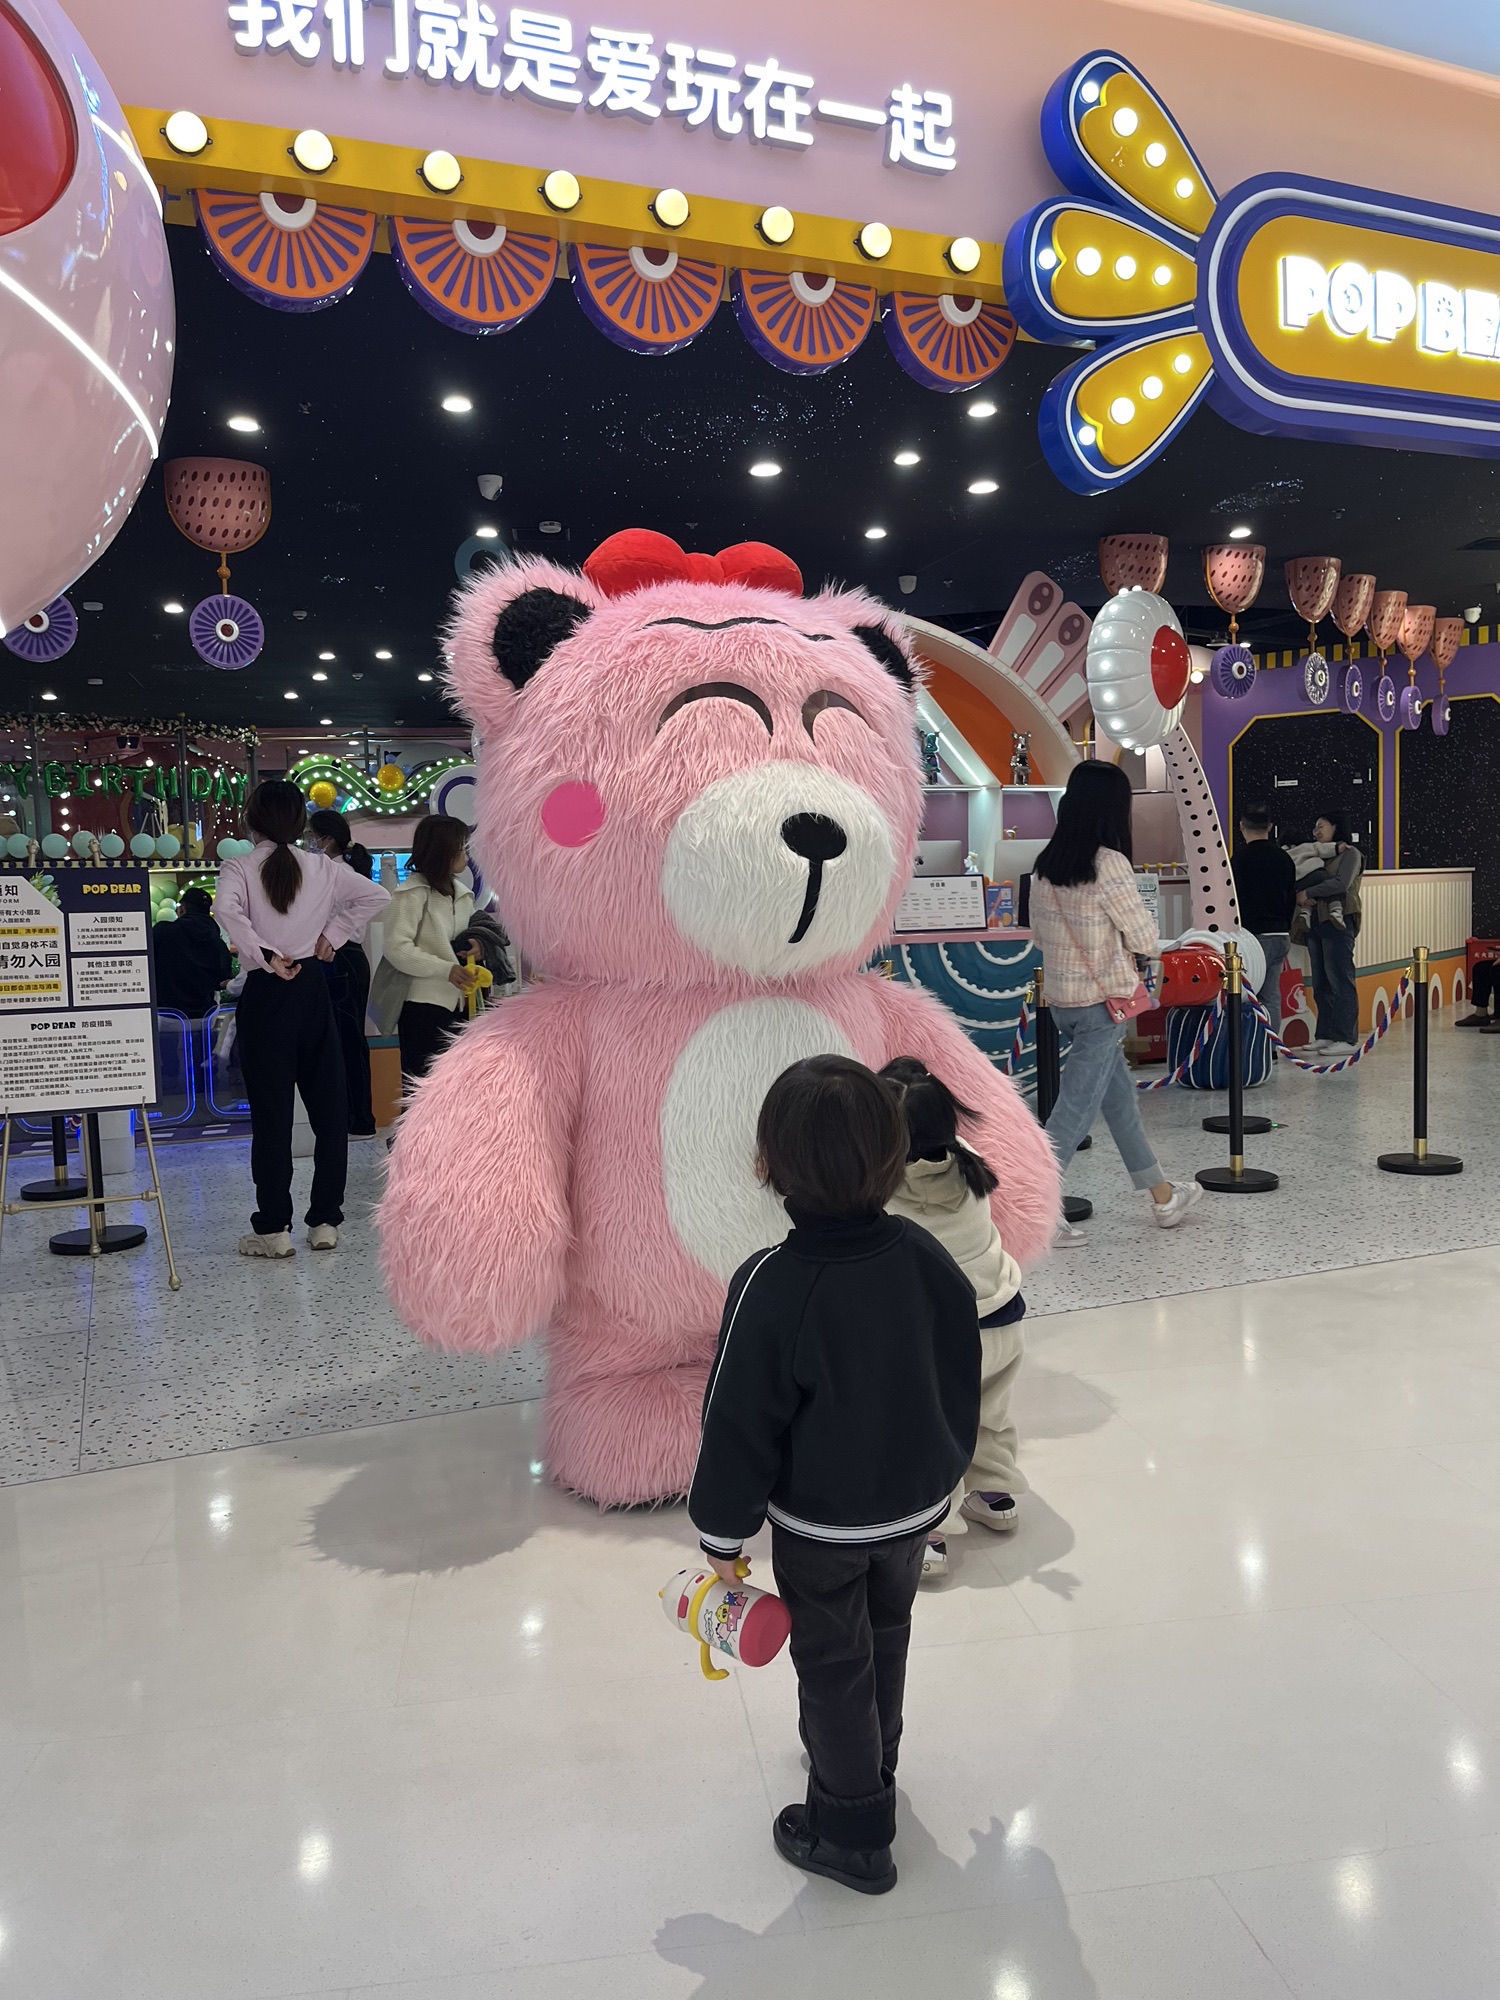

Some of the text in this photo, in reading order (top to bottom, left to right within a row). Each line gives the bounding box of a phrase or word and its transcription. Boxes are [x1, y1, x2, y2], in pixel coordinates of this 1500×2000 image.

[228, 0, 957, 172] 我们就是爱玩在一起
[1279, 256, 1500, 362] POP BE
[0, 762, 248, 807] Y BIRTHDAY
[0, 884, 18, 896] 知
[82, 884, 142, 894] POP BEAR
[0, 940, 58, 949] 自觉身体不适
[87, 960, 133, 968] 其他注意事项
[82, 1020, 112, 1028] 防疫措施
